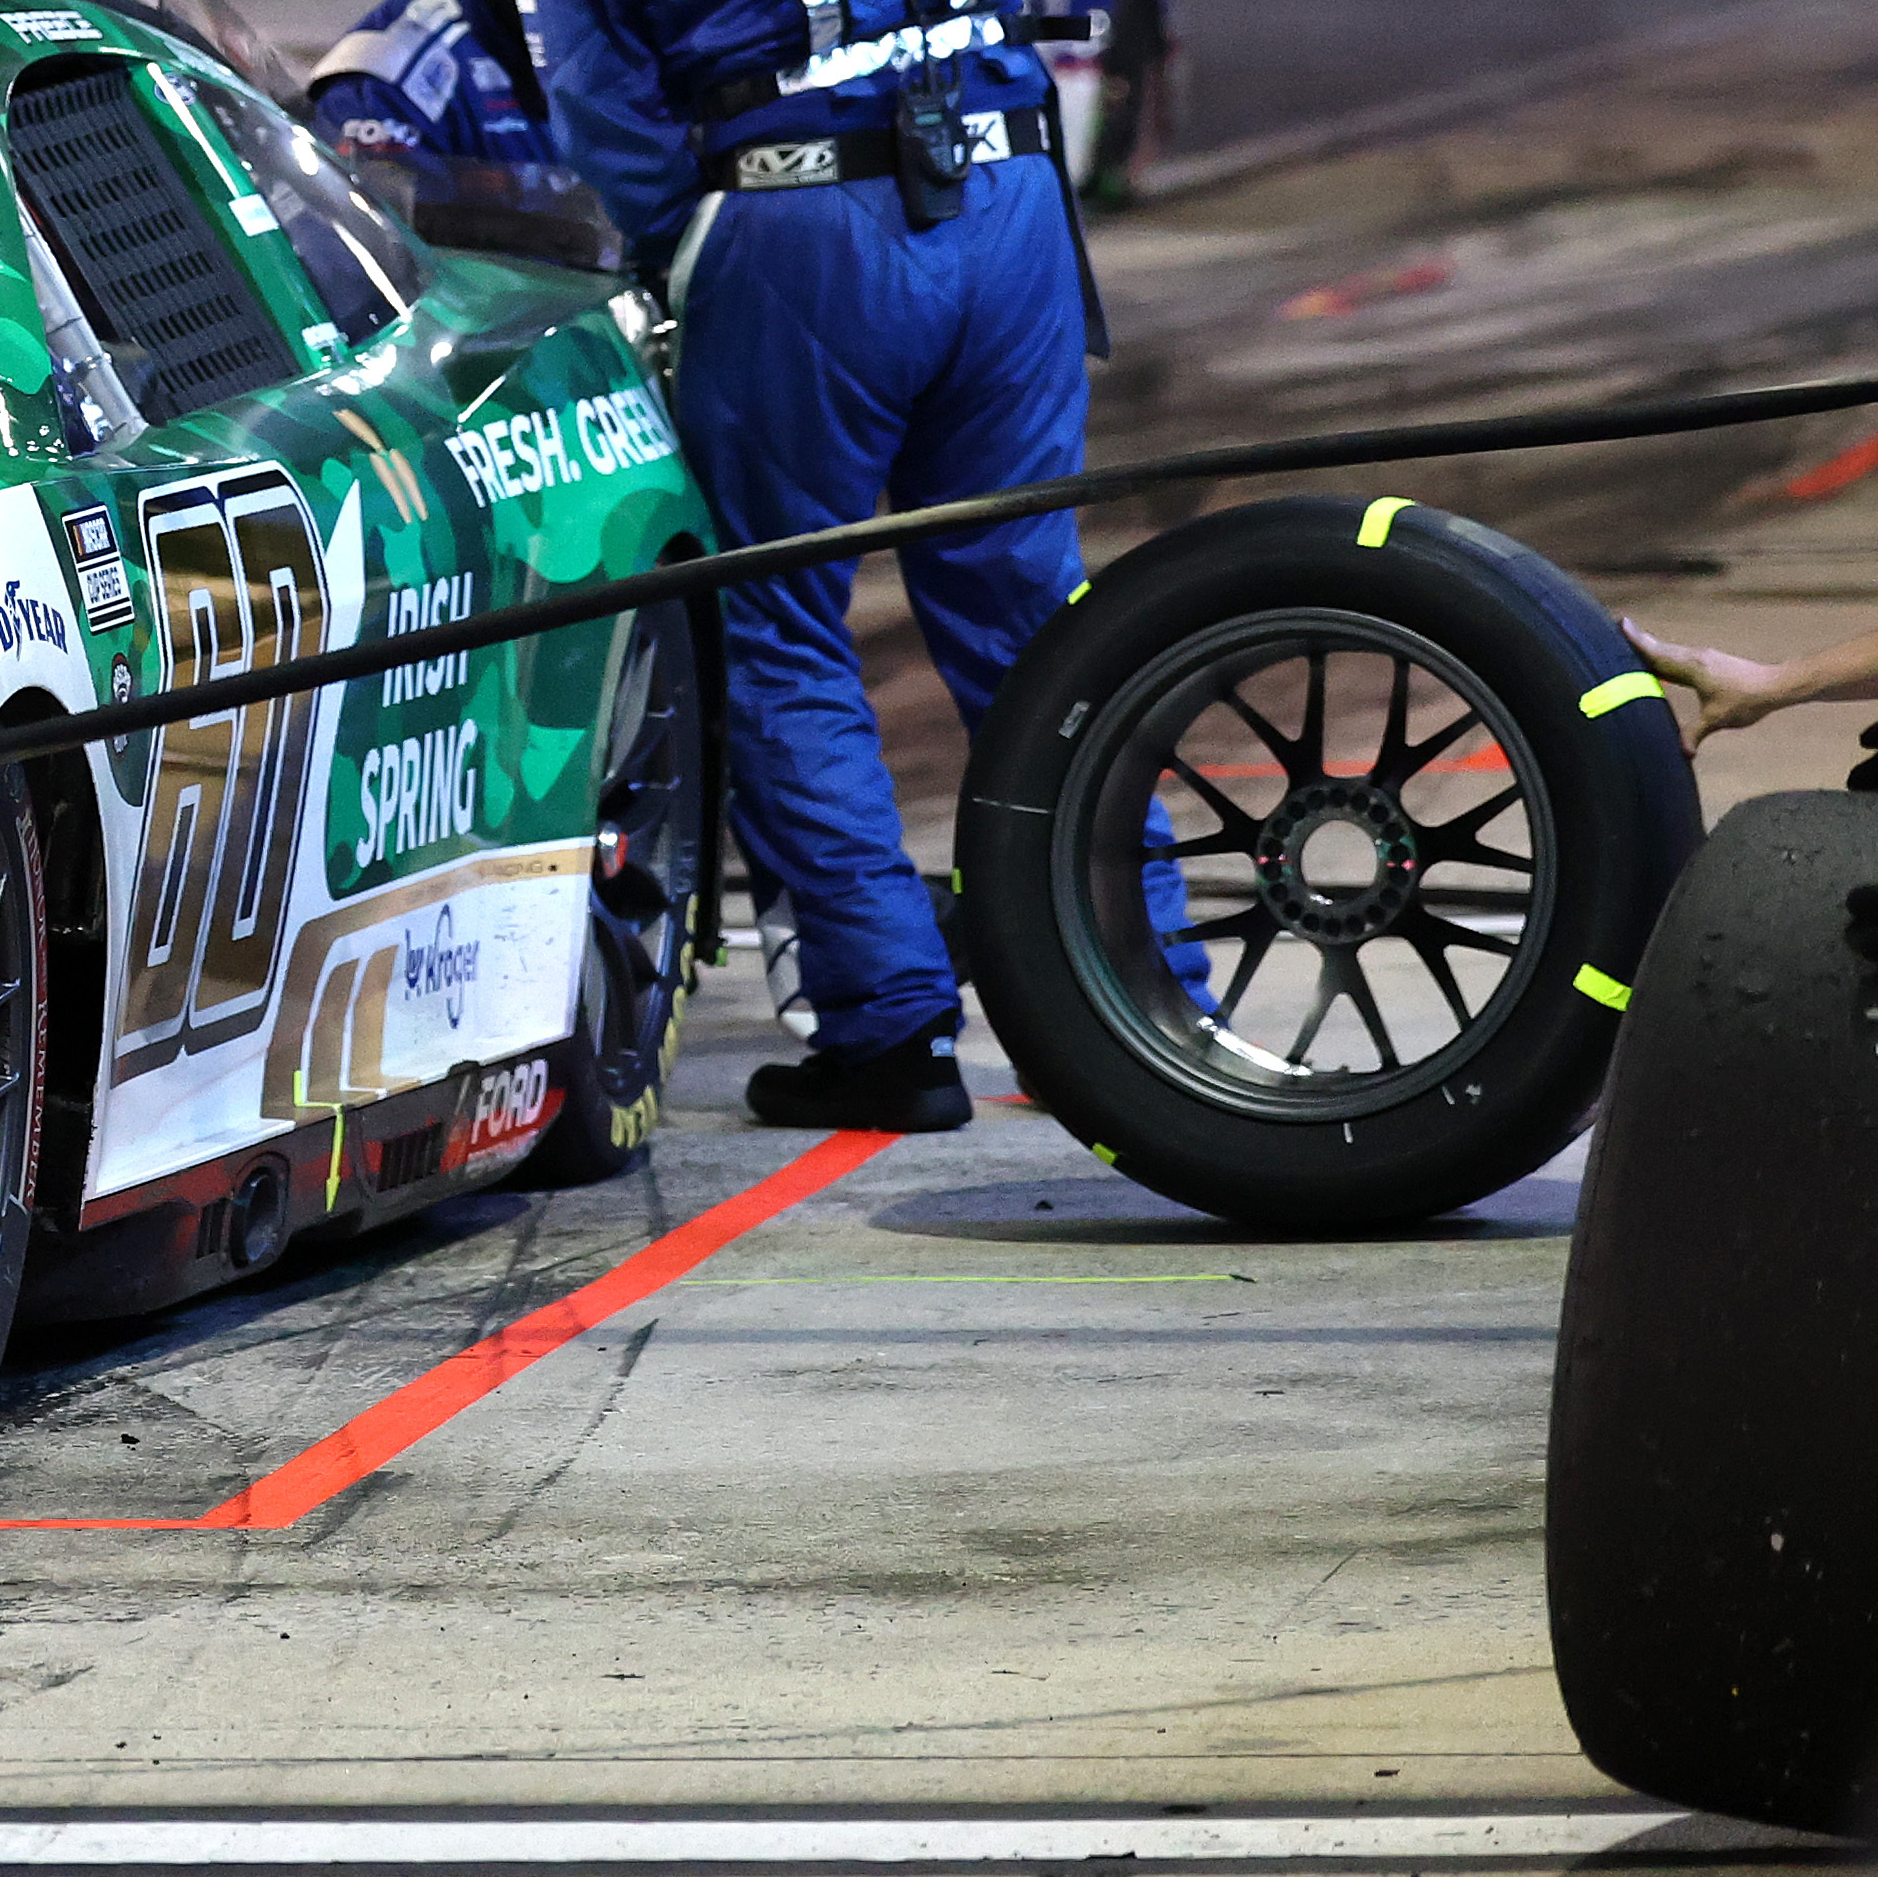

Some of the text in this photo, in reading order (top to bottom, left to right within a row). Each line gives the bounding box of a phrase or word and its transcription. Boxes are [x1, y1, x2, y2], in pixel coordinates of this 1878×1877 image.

[443, 407, 583, 508] FRESH.
[381, 571, 474, 708] IRISH
[113, 460, 330, 1088] 60
[355, 718, 479, 868] SPRING
[424, 904, 480, 1030] Kroger
[470, 1057, 550, 1145] FORD
